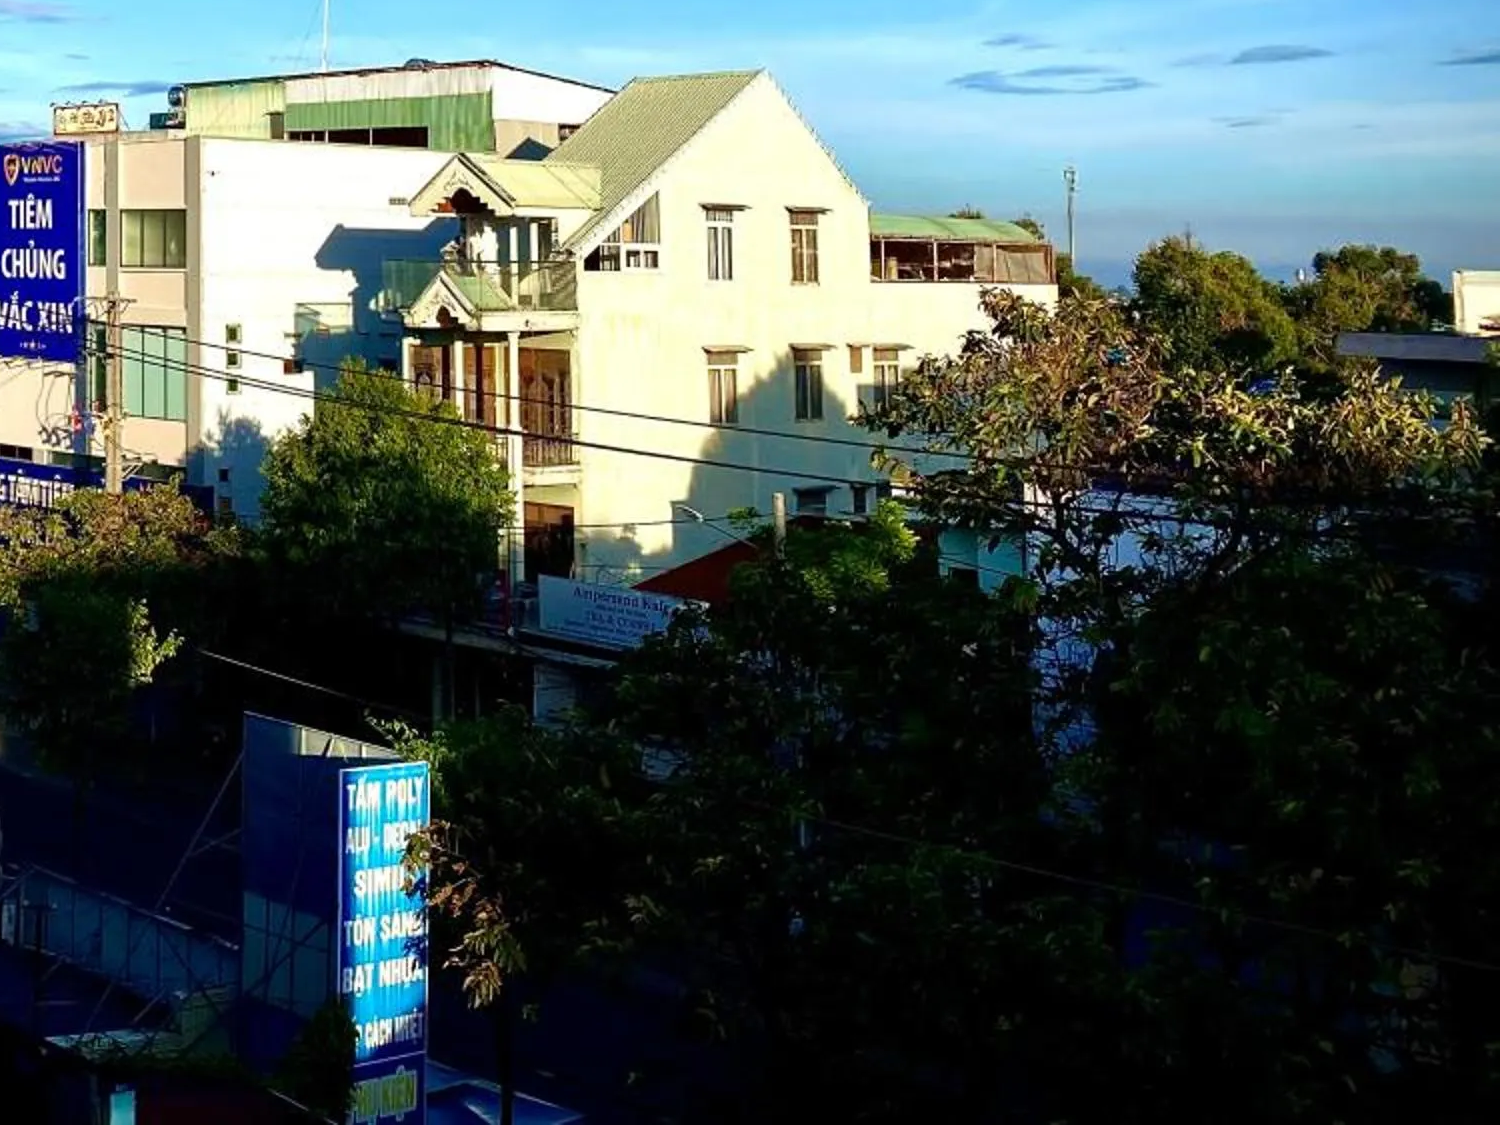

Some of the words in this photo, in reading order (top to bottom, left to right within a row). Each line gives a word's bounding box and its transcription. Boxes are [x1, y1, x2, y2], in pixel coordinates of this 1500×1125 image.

[21, 154, 63, 175] VNVC
[7, 192, 53, 229] TIÊM
[1, 239, 66, 280] CHỦNG
[37, 300, 73, 334] XIN
[7, 469, 40, 507] TÂM
[385, 776, 425, 806] POLY
[343, 913, 376, 947] TÔN
[342, 963, 375, 997] BẠT
